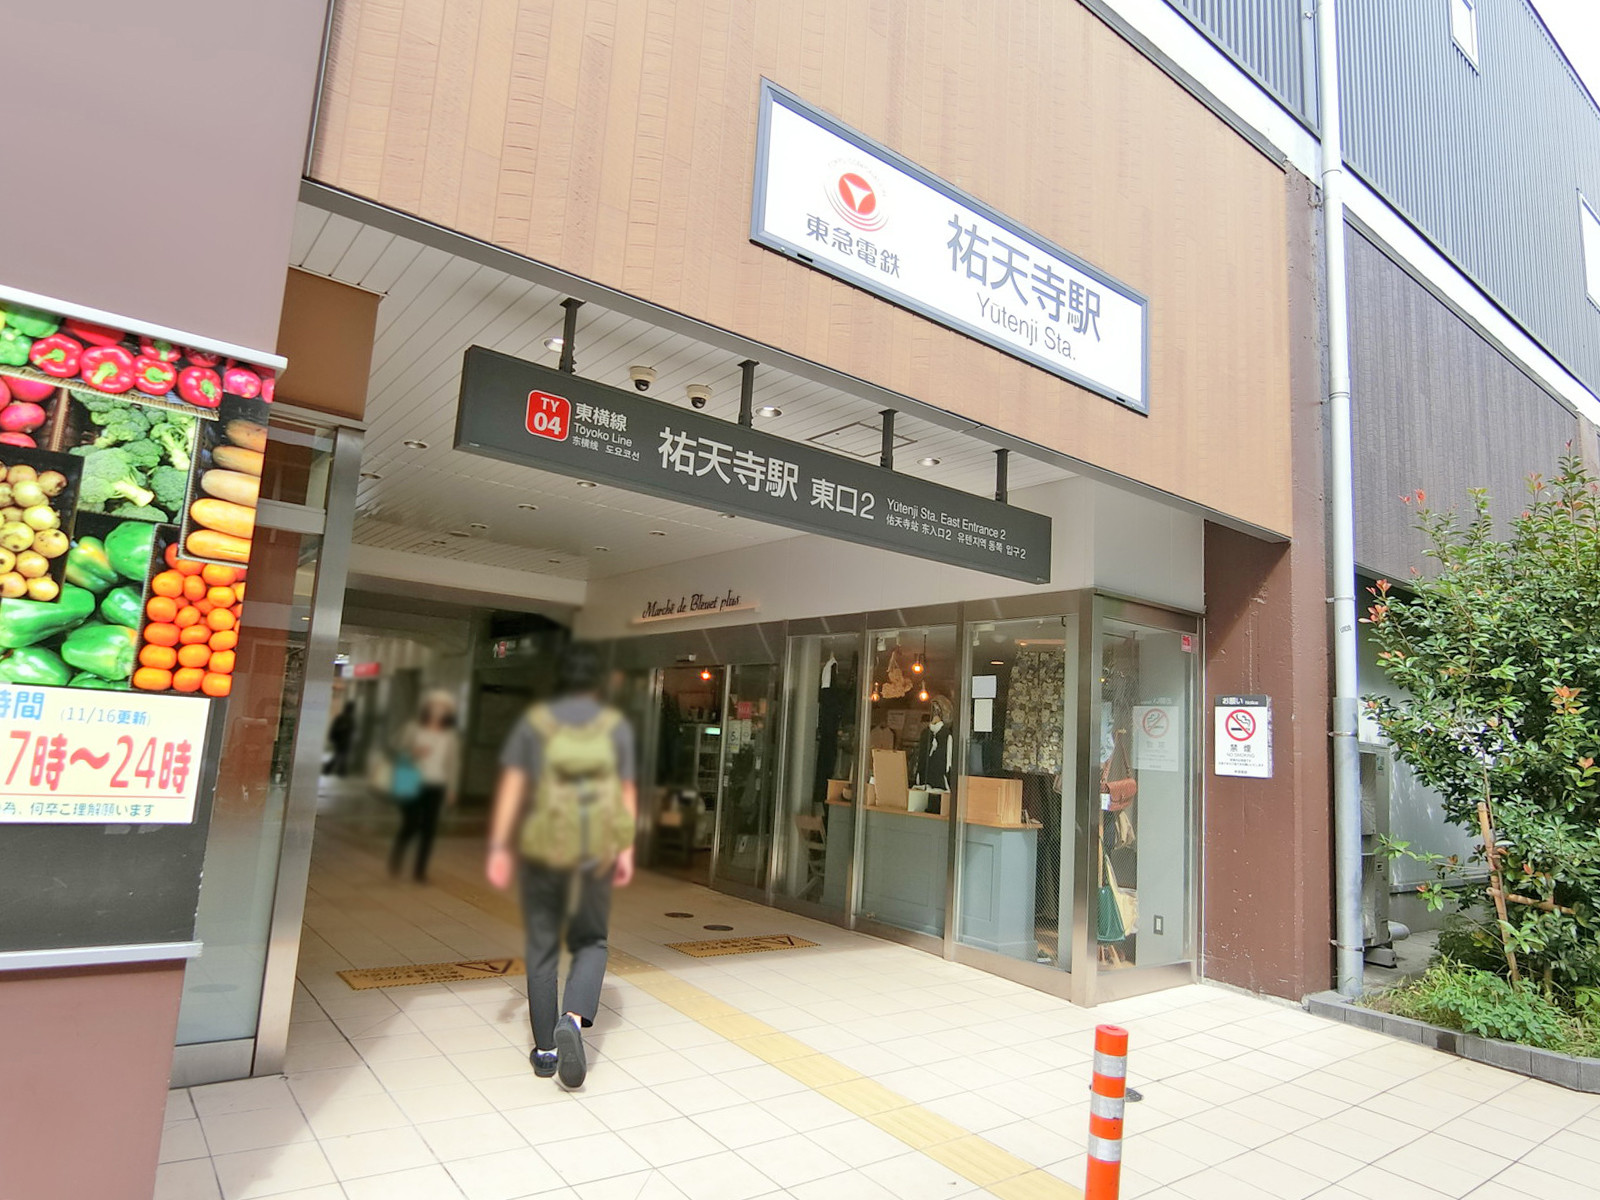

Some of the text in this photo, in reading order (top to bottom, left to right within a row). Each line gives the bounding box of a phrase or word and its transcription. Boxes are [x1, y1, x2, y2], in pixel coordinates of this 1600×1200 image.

[806, 212, 900, 279] 東急電鉄
[947, 213, 1101, 342] 祐天寺駅
[1044, 326, 1076, 361] Sta.
[540, 397, 561, 413] TY
[574, 402, 627, 432] 東横線
[534, 412, 562, 436] 04
[605, 444, 640, 462] 도요코선
[611, 432, 633, 448] Line
[658, 426, 875, 520] 祐天寺駅 東口2
[920, 507, 938, 523] Sta.
[940, 512, 961, 529] East
[961, 518, 999, 539] Entrance
[999, 528, 1006, 540] 2
[1005, 544, 1027, 560] 입구2
[676, 595, 687, 614] de
